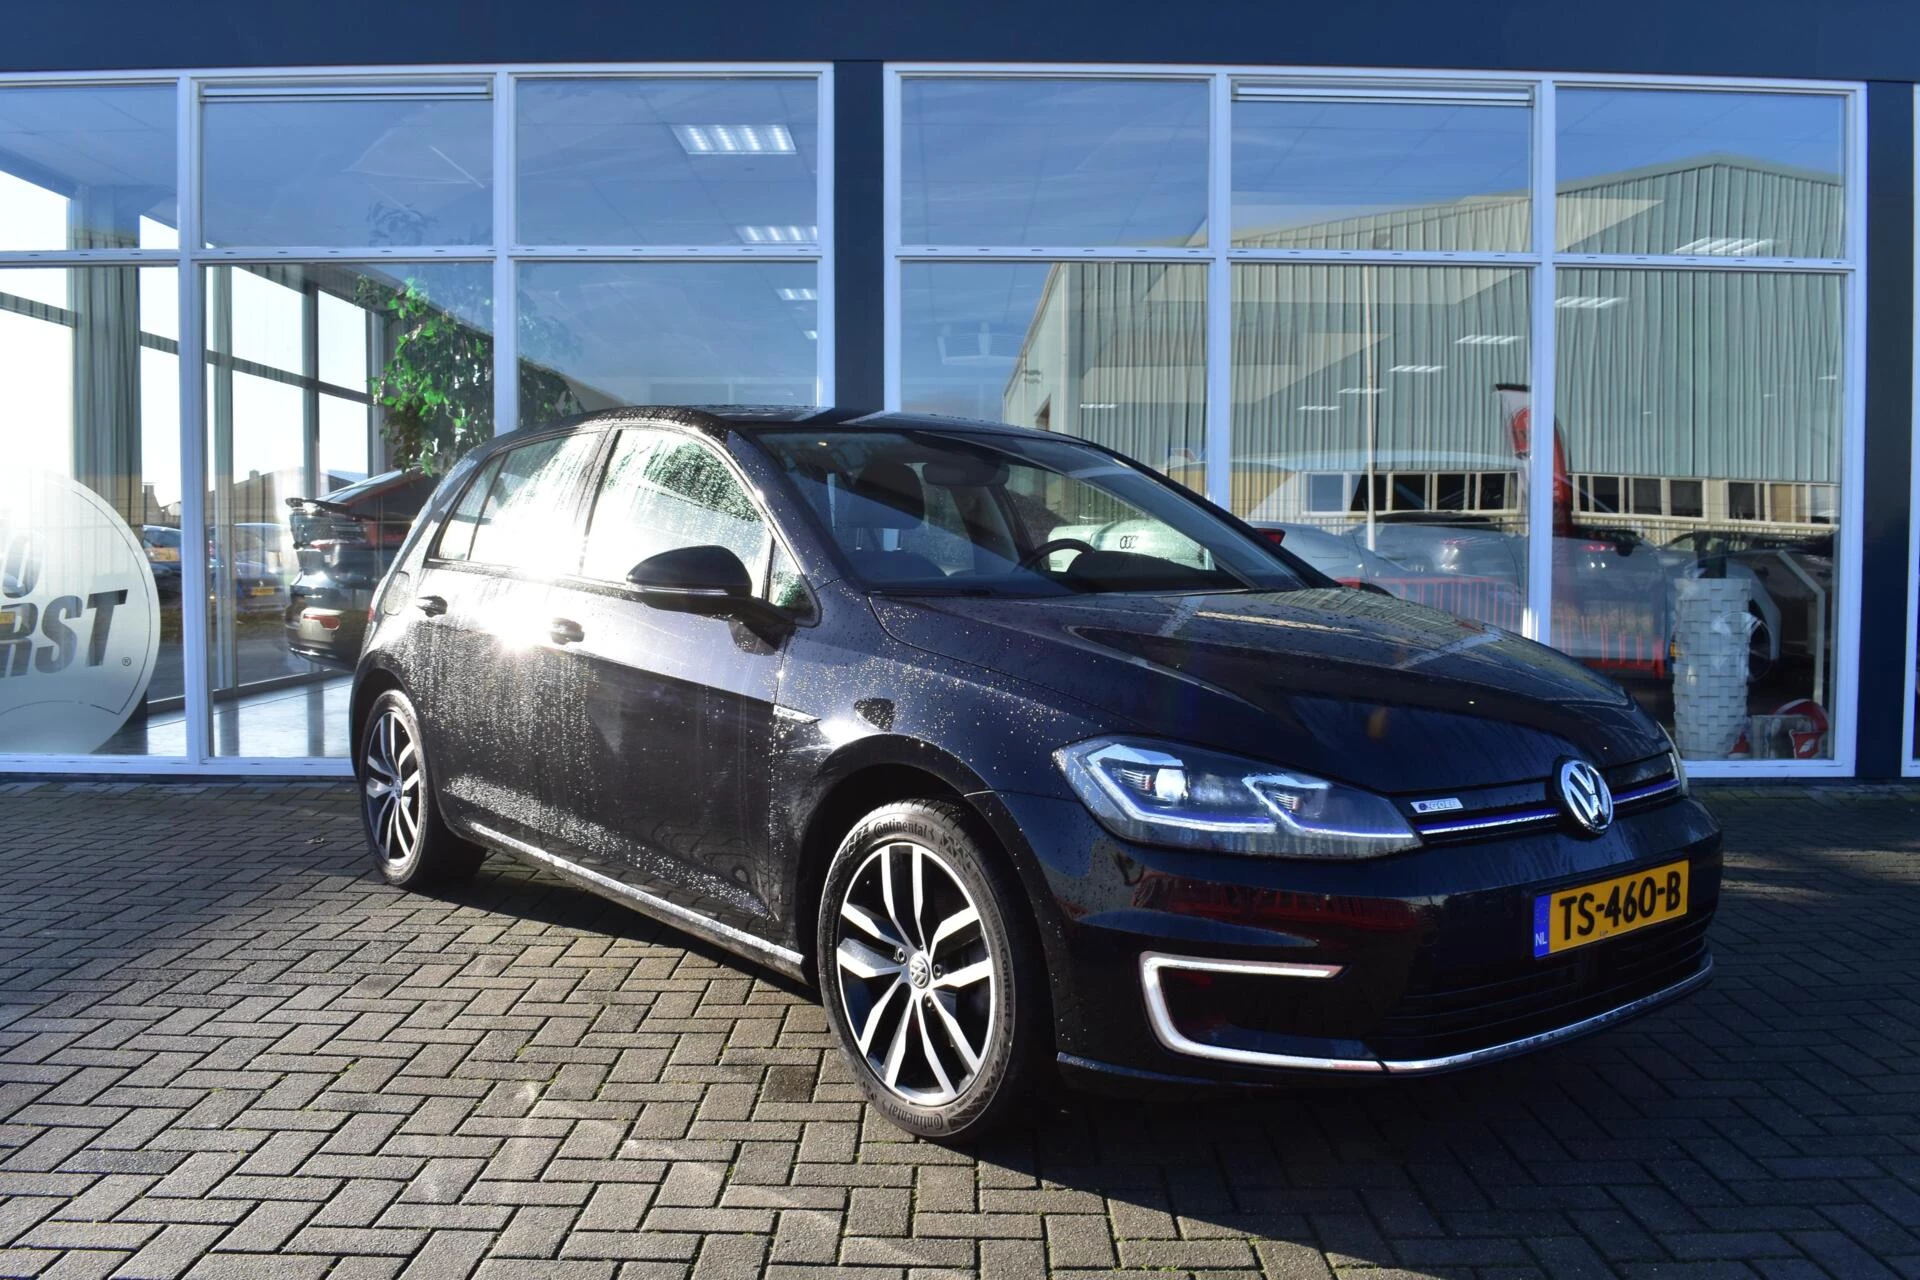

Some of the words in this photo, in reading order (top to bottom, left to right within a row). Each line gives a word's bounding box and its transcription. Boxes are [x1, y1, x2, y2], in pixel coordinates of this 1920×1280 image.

[873, 818, 928, 838] Continental
[1560, 871, 1681, 940] TS-460-B
[1535, 932, 1547, 946] NL
[889, 1103, 944, 1131] Continental
